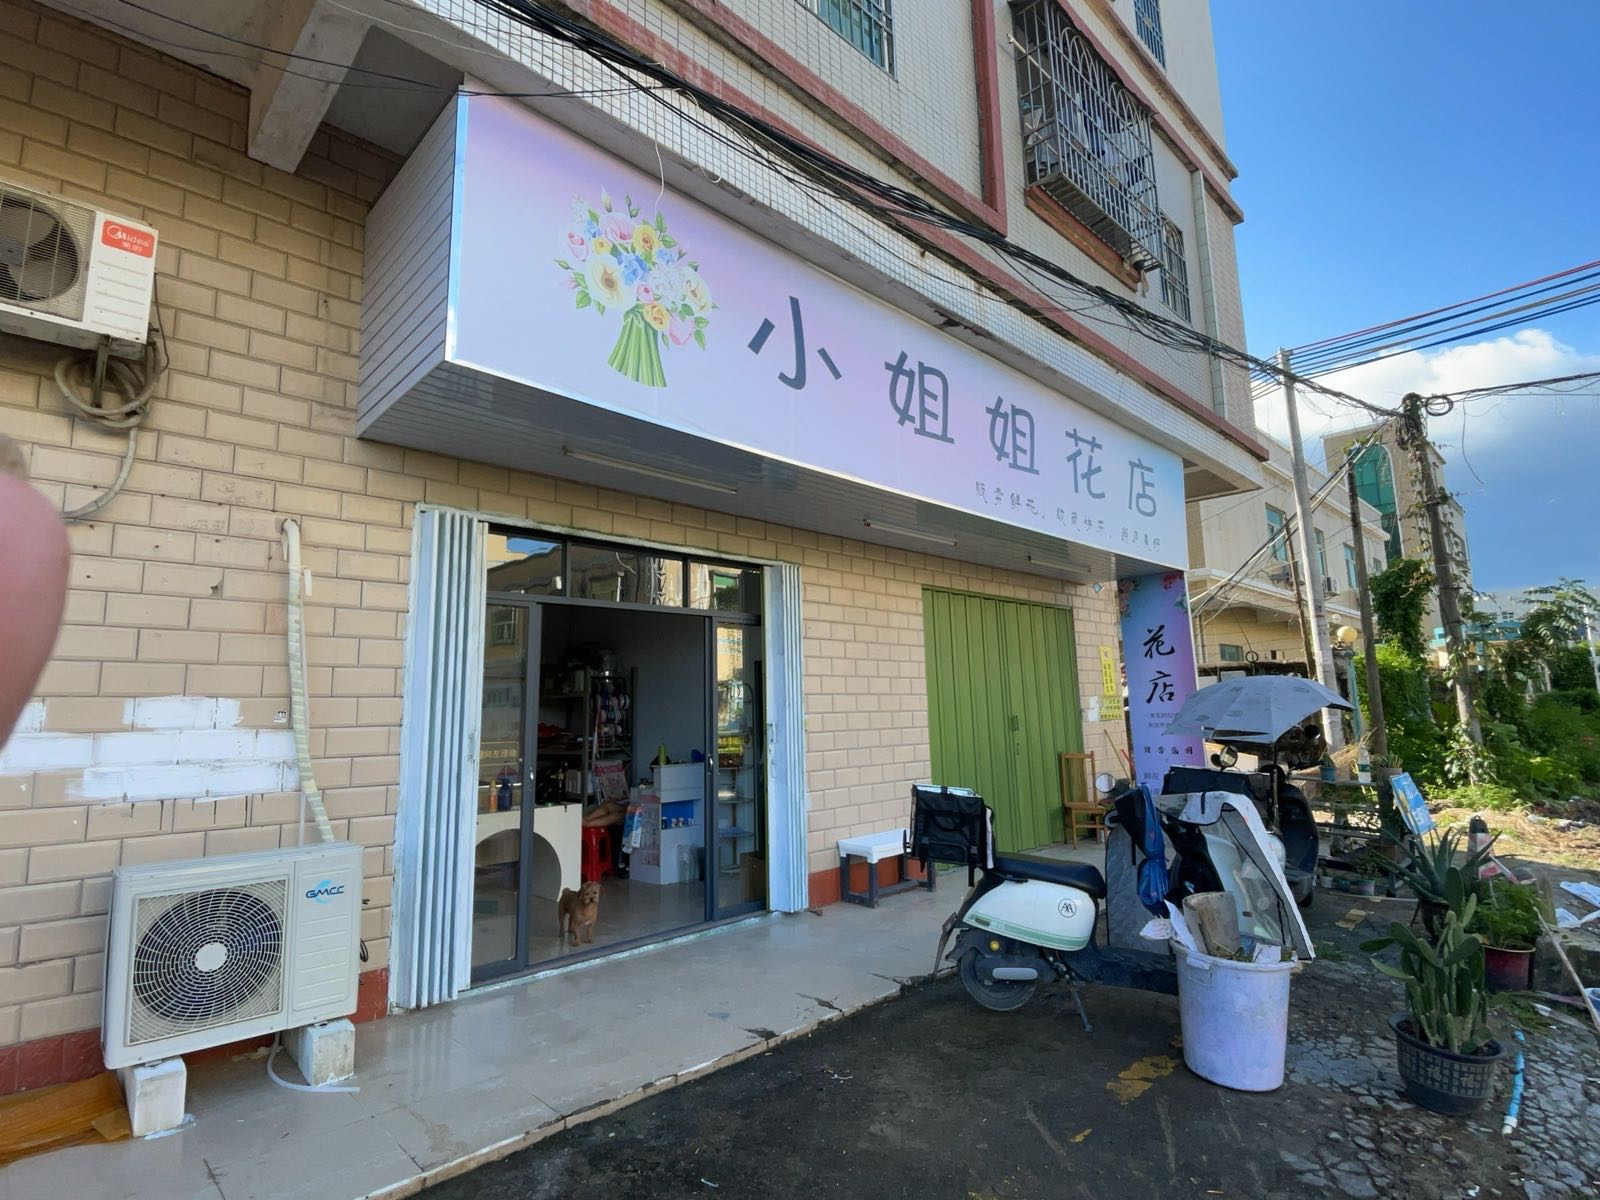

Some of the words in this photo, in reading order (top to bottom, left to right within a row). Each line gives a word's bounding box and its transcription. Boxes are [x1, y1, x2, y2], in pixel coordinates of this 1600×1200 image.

[107, 225, 149, 247] Midea
[748, 296, 1157, 517] 小姐姐花店
[1143, 624, 1175, 703] 花店
[305, 885, 345, 899] GMCC
